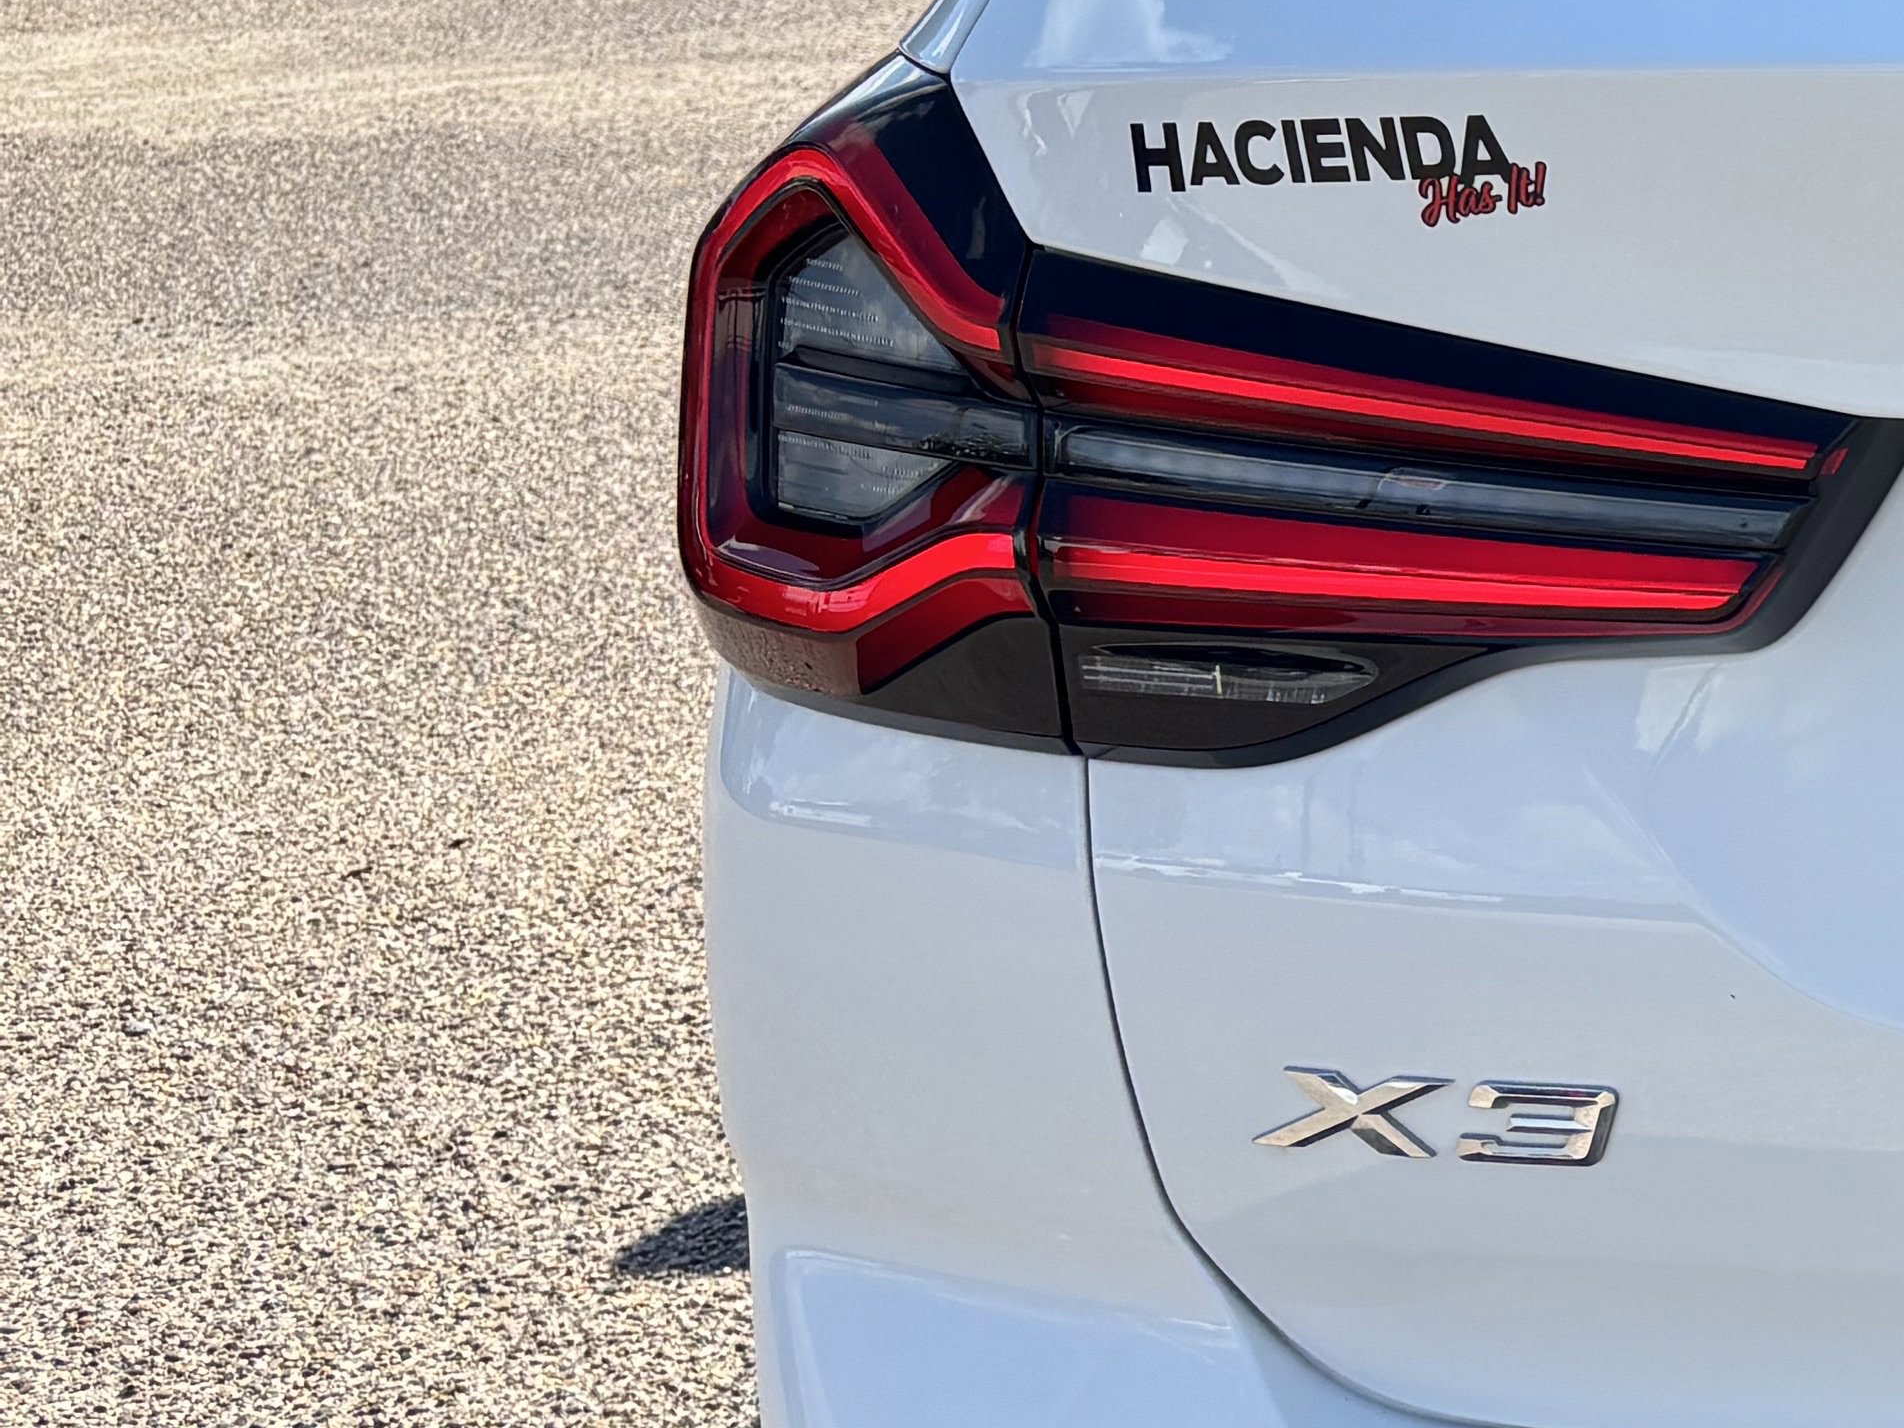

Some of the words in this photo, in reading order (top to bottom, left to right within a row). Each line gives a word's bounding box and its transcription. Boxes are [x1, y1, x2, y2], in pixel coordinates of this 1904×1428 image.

[1130, 114, 1515, 193] HACIENDA
[1418, 172, 1503, 228] Has
[1506, 160, 1548, 215] It!
[1252, 1065, 1620, 1167] X3
